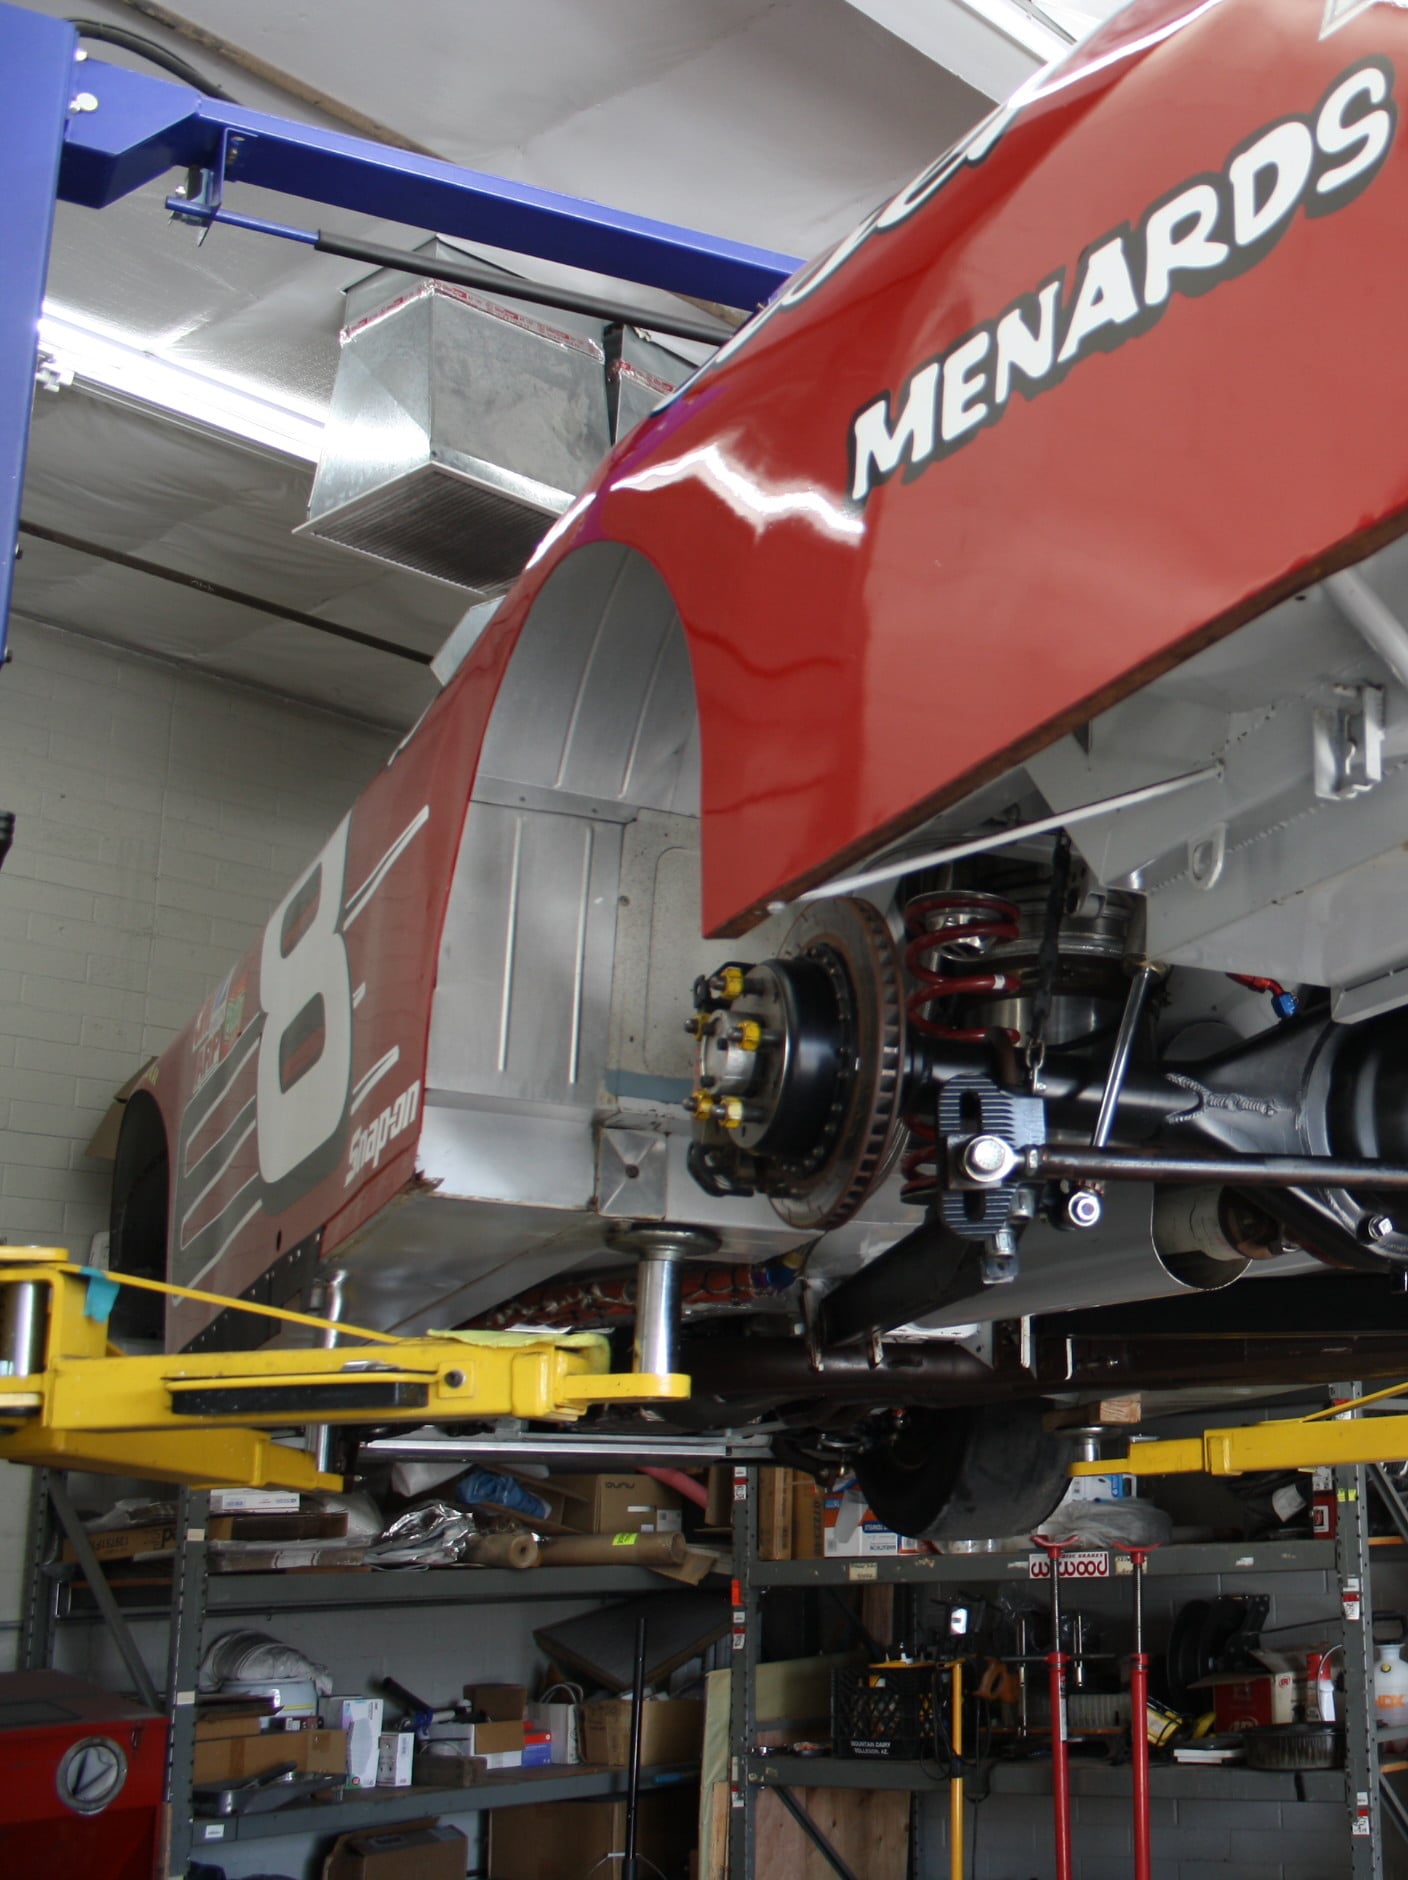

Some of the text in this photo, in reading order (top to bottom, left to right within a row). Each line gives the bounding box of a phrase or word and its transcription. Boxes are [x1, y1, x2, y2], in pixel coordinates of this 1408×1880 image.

[848, 62, 1395, 502] MENARDS
[255, 812, 354, 1184] 8
[344, 1079, 421, 1188] Snap-on
[1031, 1553, 1108, 1577] wwood
